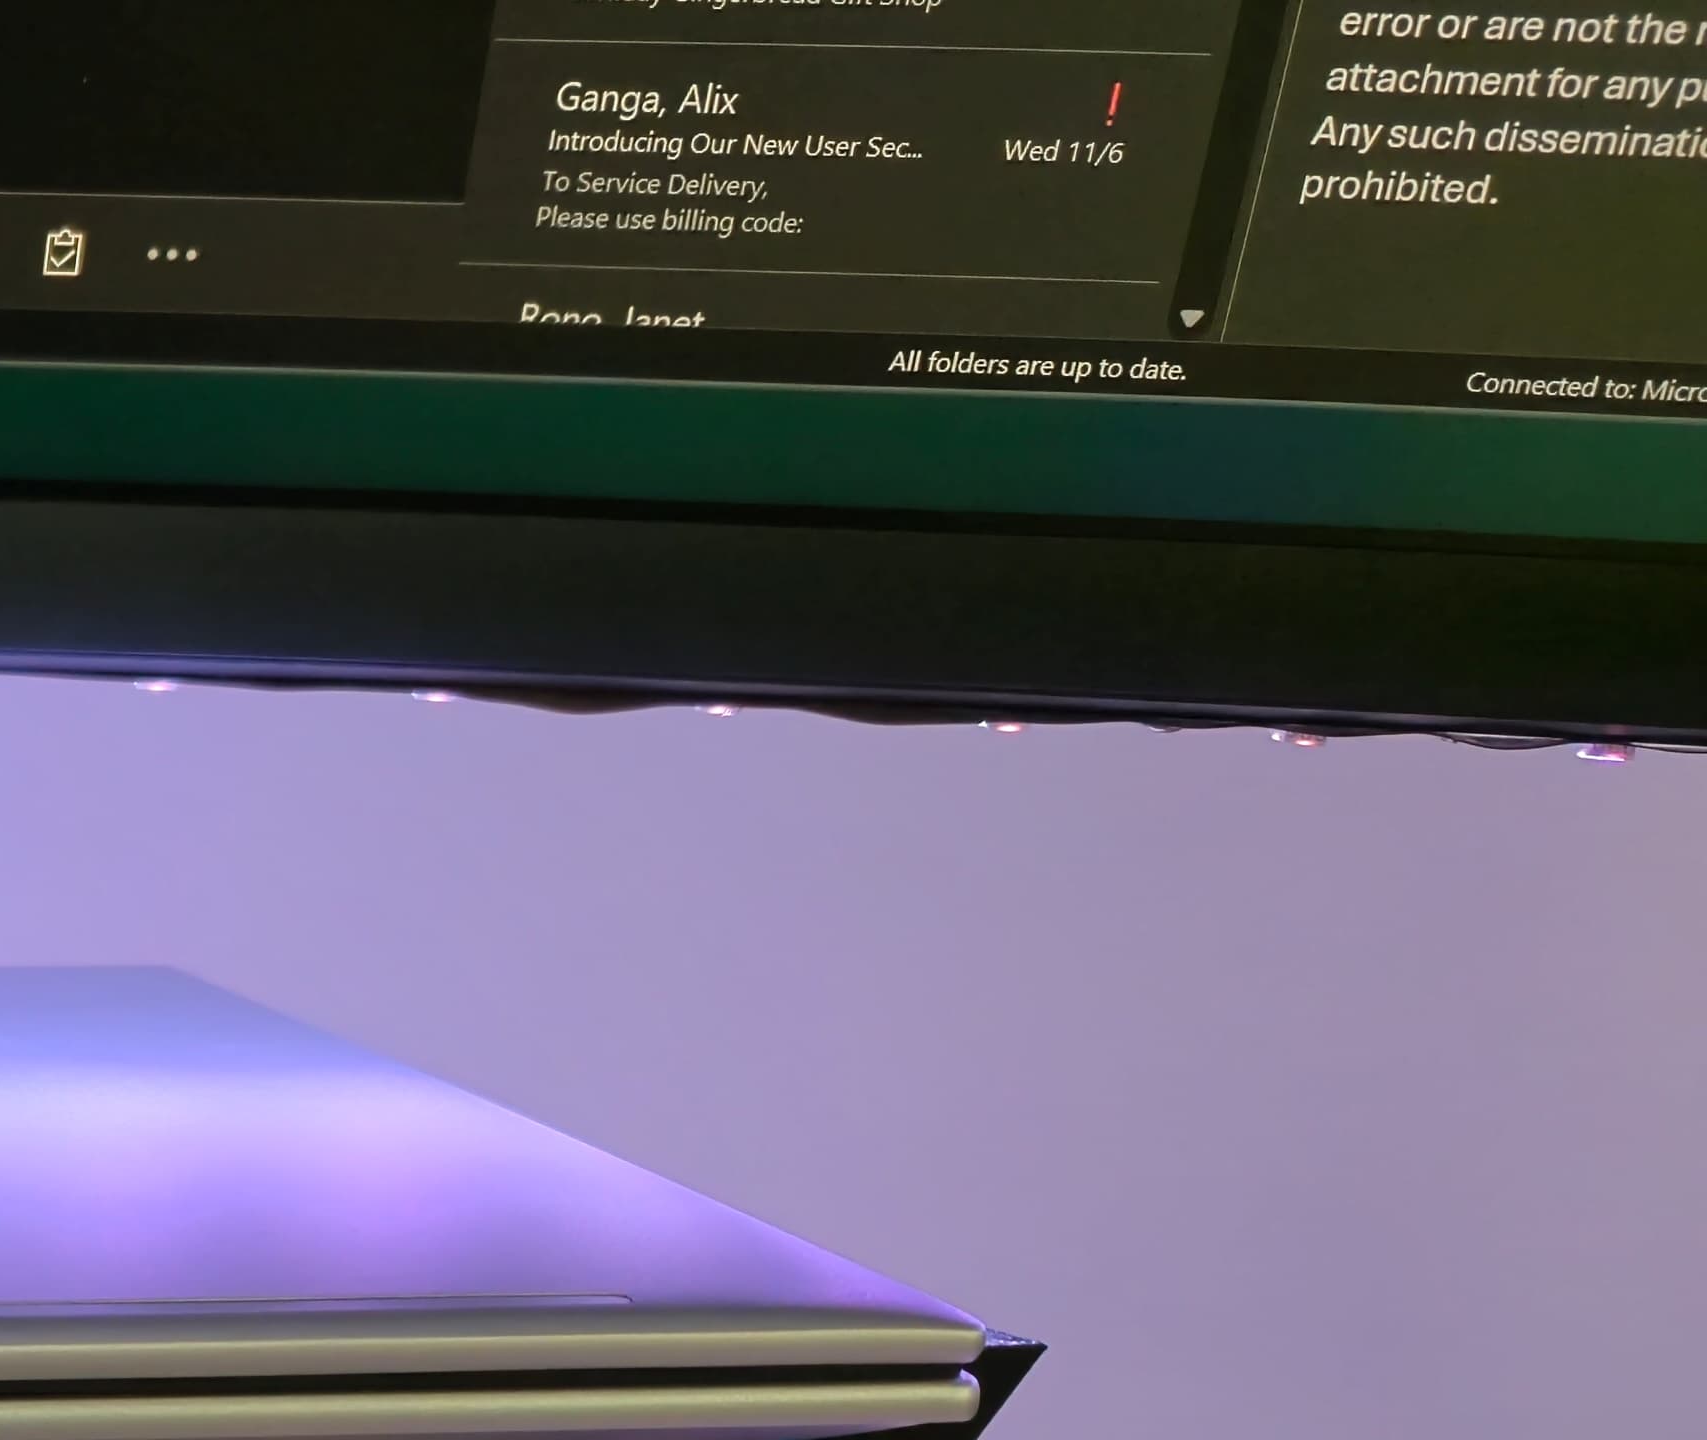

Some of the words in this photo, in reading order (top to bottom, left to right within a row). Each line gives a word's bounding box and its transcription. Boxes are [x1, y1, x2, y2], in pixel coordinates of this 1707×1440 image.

[1339, 11, 1430, 39] error
[1437, 14, 1477, 40] or
[1484, 16, 1544, 41] are
[1553, 14, 1618, 43] not
[1626, 13, 1687, 44] the
[556, 81, 666, 121] Ganga,
[678, 83, 739, 115] Alix
[1326, 63, 1540, 98] attachment
[1546, 67, 1599, 98] for
[1603, 75, 1674, 108] any
[1675, 77, 1707, 109] p
[548, 129, 683, 160] Introducing
[690, 133, 737, 154] Our
[743, 134, 798, 156] New
[805, 135, 861, 157] User
[865, 137, 923, 158] Sec...
[1310, 115, 1384, 154] Any
[1387, 120, 1476, 151] such
[1005, 139, 1060, 162] Wed
[1069, 141, 1125, 166] 11/6
[543, 170, 569, 192] To
[576, 171, 660, 194] Service
[668, 173, 768, 202] Delivery,
[1299, 171, 1499, 204] prohibited.
[536, 206, 608, 229] Please
[615, 211, 655, 230] use
[662, 208, 734, 238] billing
[742, 212, 803, 234] code:
[888, 350, 921, 372] All
[928, 350, 1009, 374] folders
[1015, 359, 1054, 377] are
[1061, 361, 1092, 383] up
[1099, 359, 1123, 379] to
[1130, 357, 1187, 380] date.
[1467, 372, 1599, 398] Connected
[1605, 379, 1637, 399] to:
